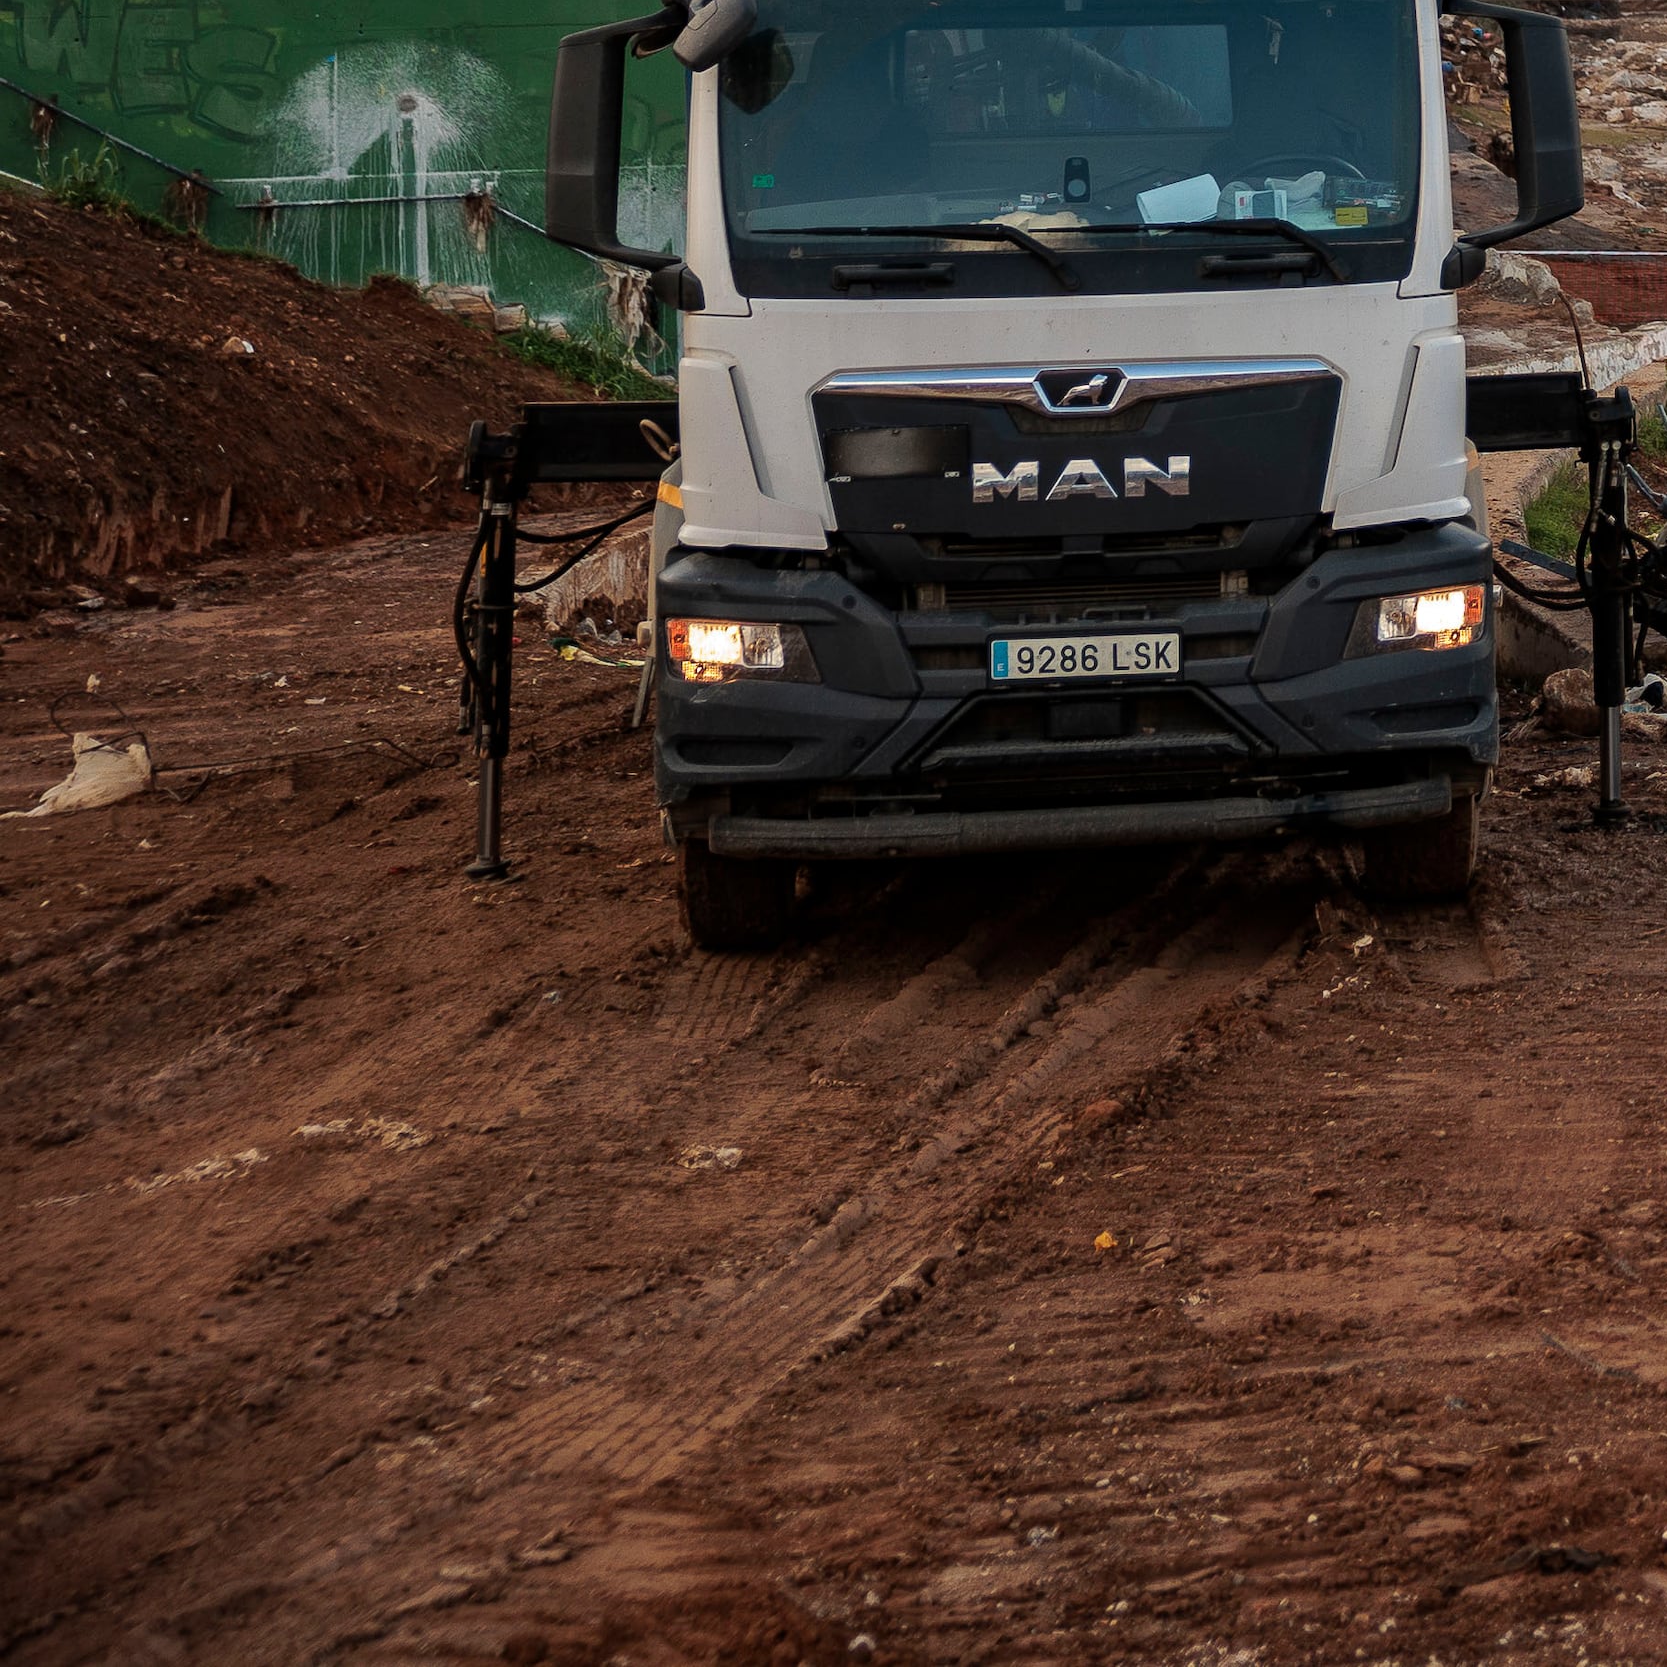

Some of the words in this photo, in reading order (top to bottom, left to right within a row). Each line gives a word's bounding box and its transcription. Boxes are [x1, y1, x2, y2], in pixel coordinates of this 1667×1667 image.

[971, 455, 1191, 503] MAN
[996, 663, 1005, 672] E
[1017, 644, 1099, 674] 9286
[1112, 640, 1172, 671] LSK
